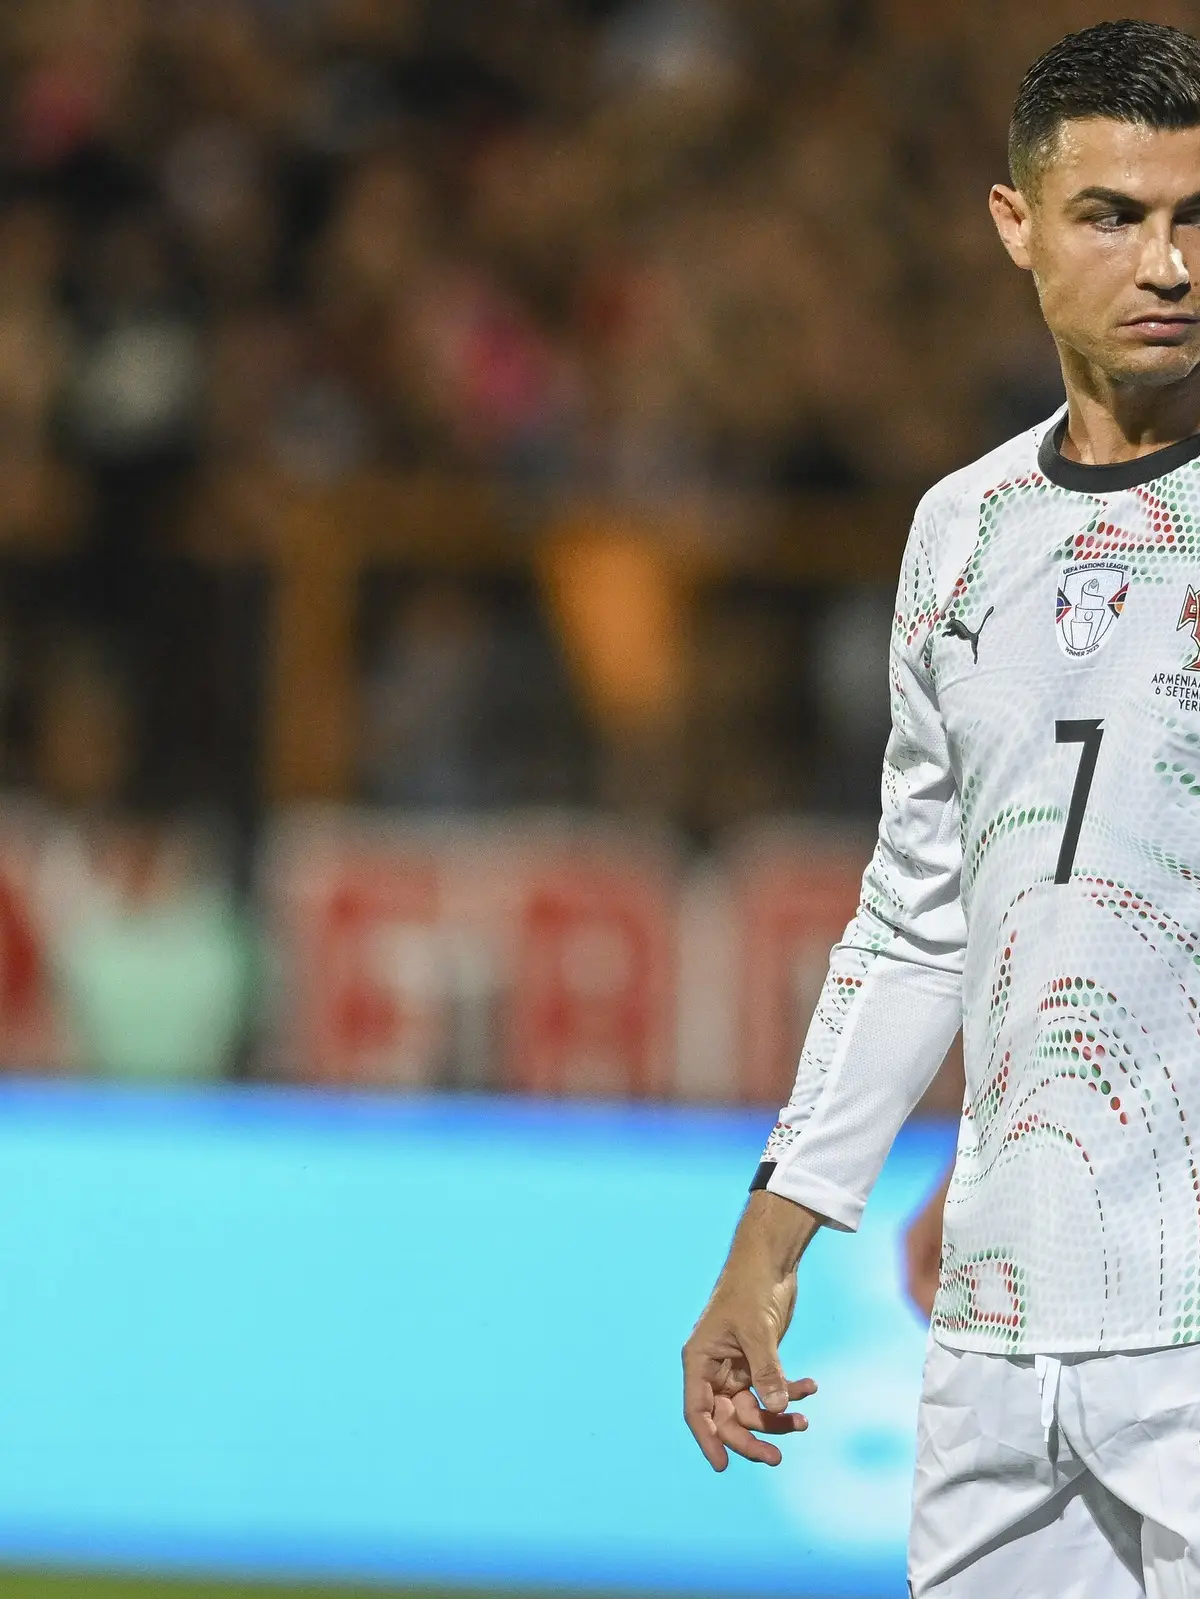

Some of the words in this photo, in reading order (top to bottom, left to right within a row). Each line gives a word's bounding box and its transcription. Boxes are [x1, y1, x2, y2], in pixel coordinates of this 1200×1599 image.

[1063, 566, 1078, 574] UEFA
[1079, 562, 1105, 570] NATIONS
[1106, 562, 1129, 572] LEAGUE
[1155, 685, 1161, 695] 6
[1054, 718, 1105, 885] 7
